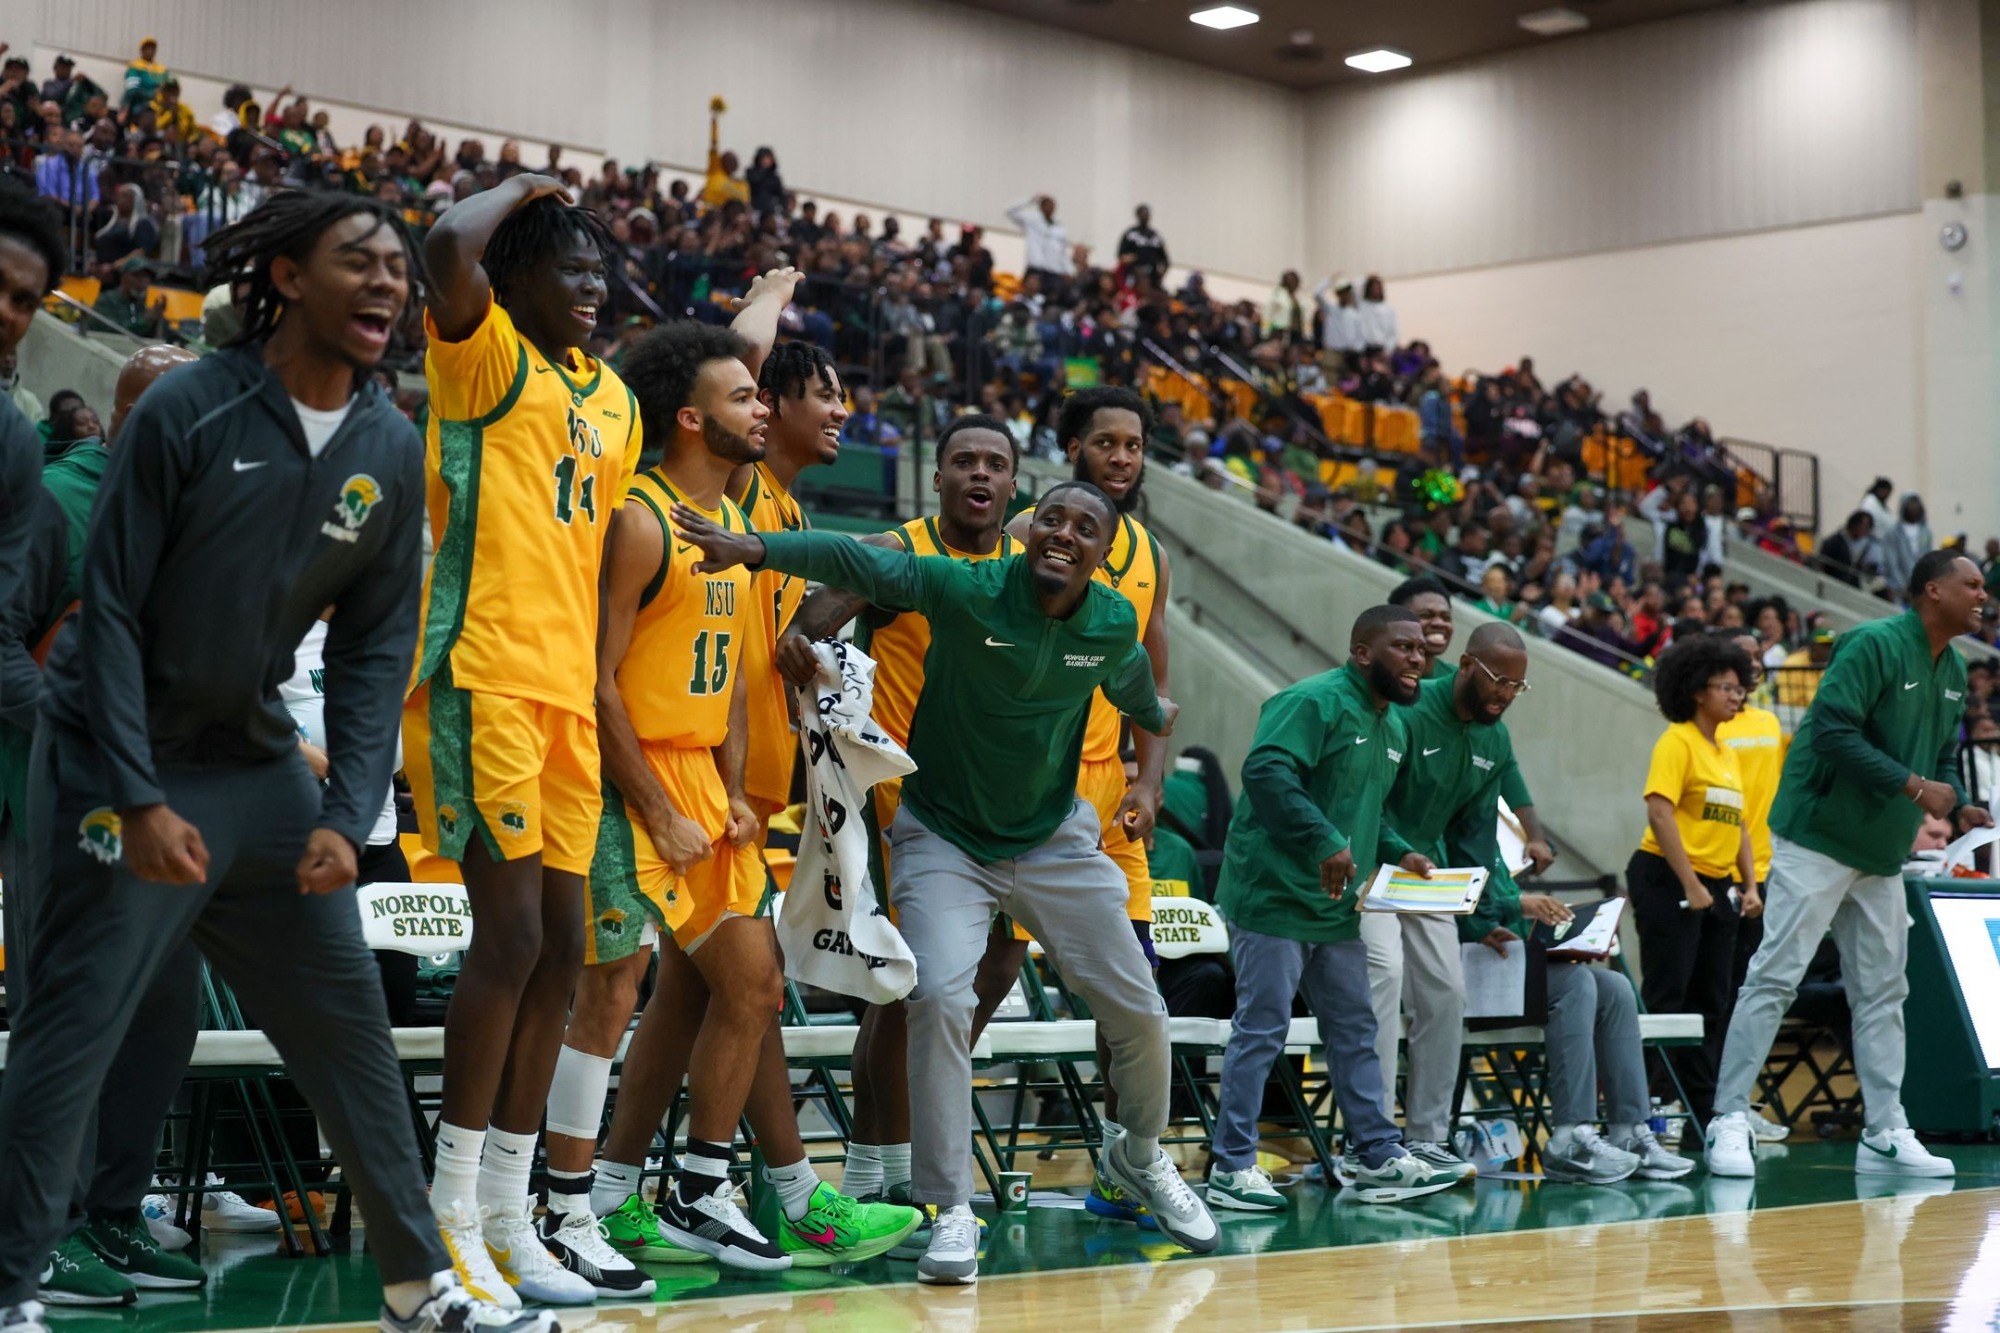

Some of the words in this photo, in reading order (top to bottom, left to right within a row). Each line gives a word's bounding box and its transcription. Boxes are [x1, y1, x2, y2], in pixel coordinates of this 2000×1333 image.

[567, 406, 602, 459] NSU
[553, 455, 595, 524] 14
[704, 581, 735, 616] NSU
[689, 630, 731, 695] 15
[393, 917, 463, 937] STATE
[1151, 909, 1213, 927] ORFOLK
[1154, 927, 1201, 943] STATE
[1008, 1180, 1026, 1202] G
